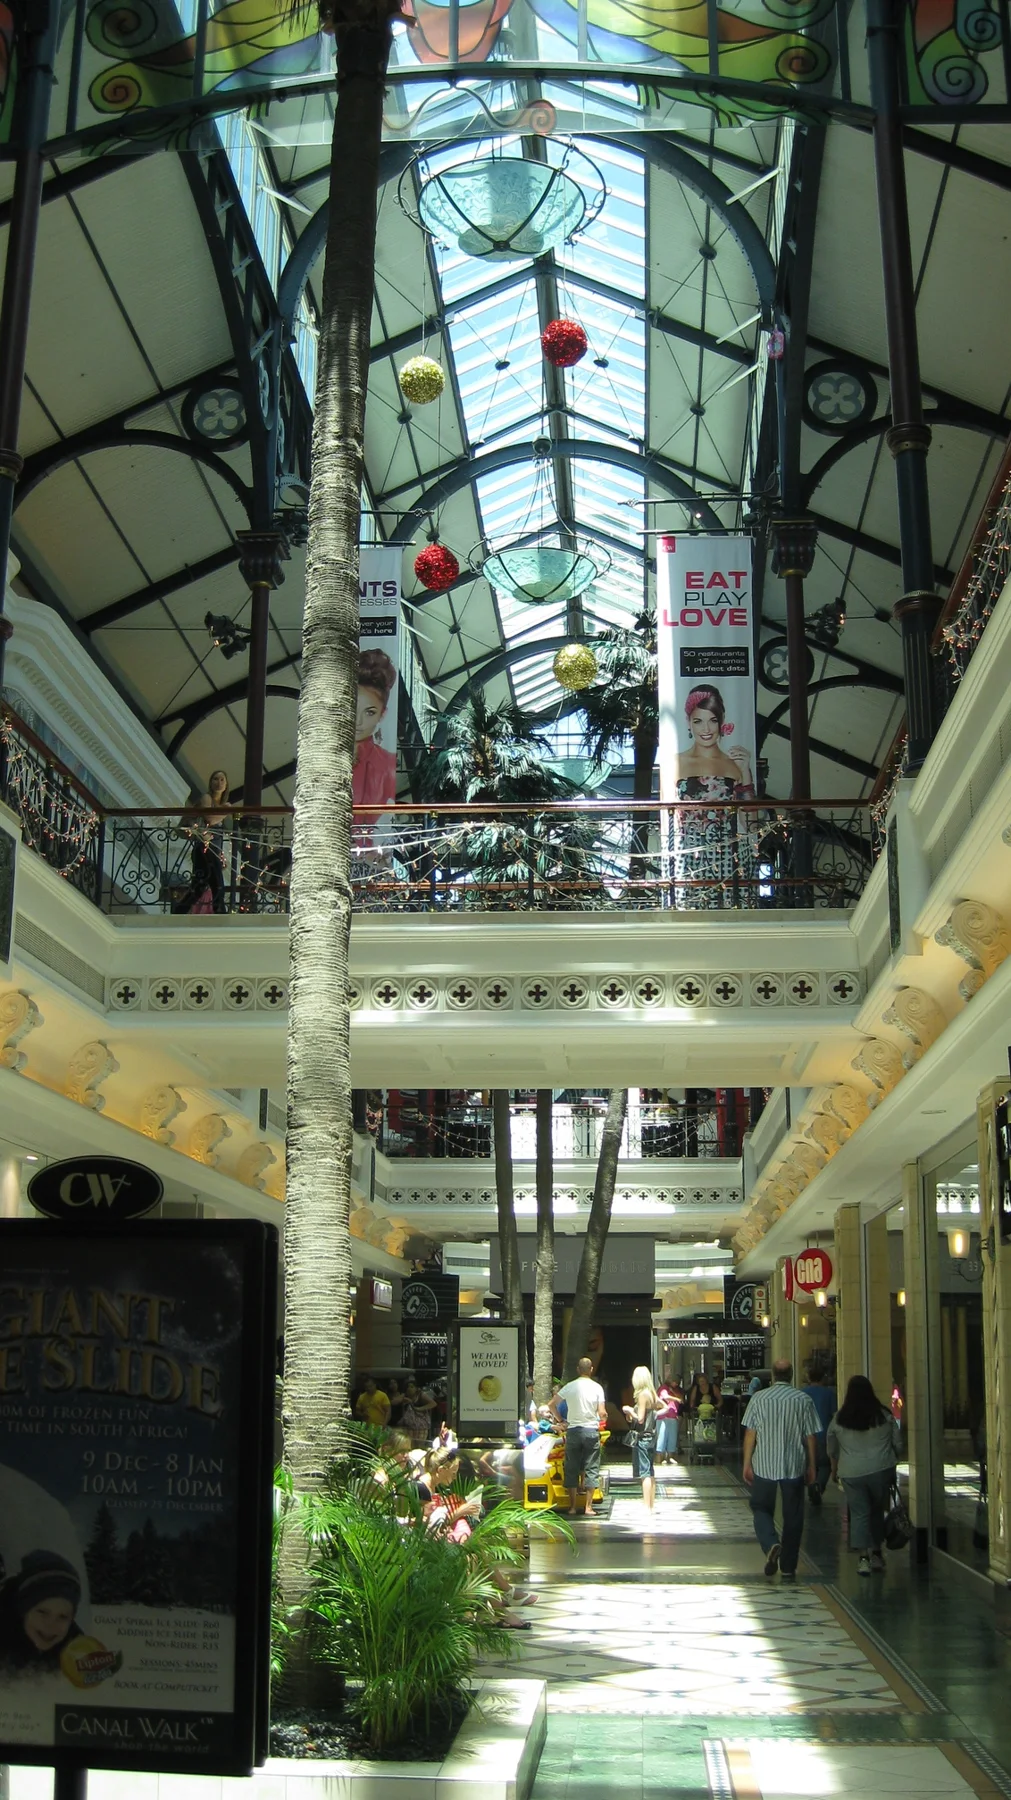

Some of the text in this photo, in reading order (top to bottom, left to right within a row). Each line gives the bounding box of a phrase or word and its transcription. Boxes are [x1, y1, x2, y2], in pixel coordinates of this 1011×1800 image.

[686, 571, 748, 589] EAT
[684, 591, 748, 606] PLAY
[663, 608, 748, 626] LOVE
[471, 1352, 509, 1360] WE HAVE
[472, 1360, 509, 1368] MOVED!
[42, 1336, 224, 1419] SLIDE
[28, 1405, 48, 1418] OF
[53, 1407, 113, 1420] FROZEN
[118, 1409, 150, 1421] FUN
[7, 1420, 188, 1439] TIME IN SOUTH AFRICA!
[82, 1450, 95, 1469] 9
[166, 1453, 179, 1473] 8
[77, 1654, 113, 1670] Lipton
[113, 1680, 140, 1689] BOOK
[114, 1741, 210, 1753] shop the world
